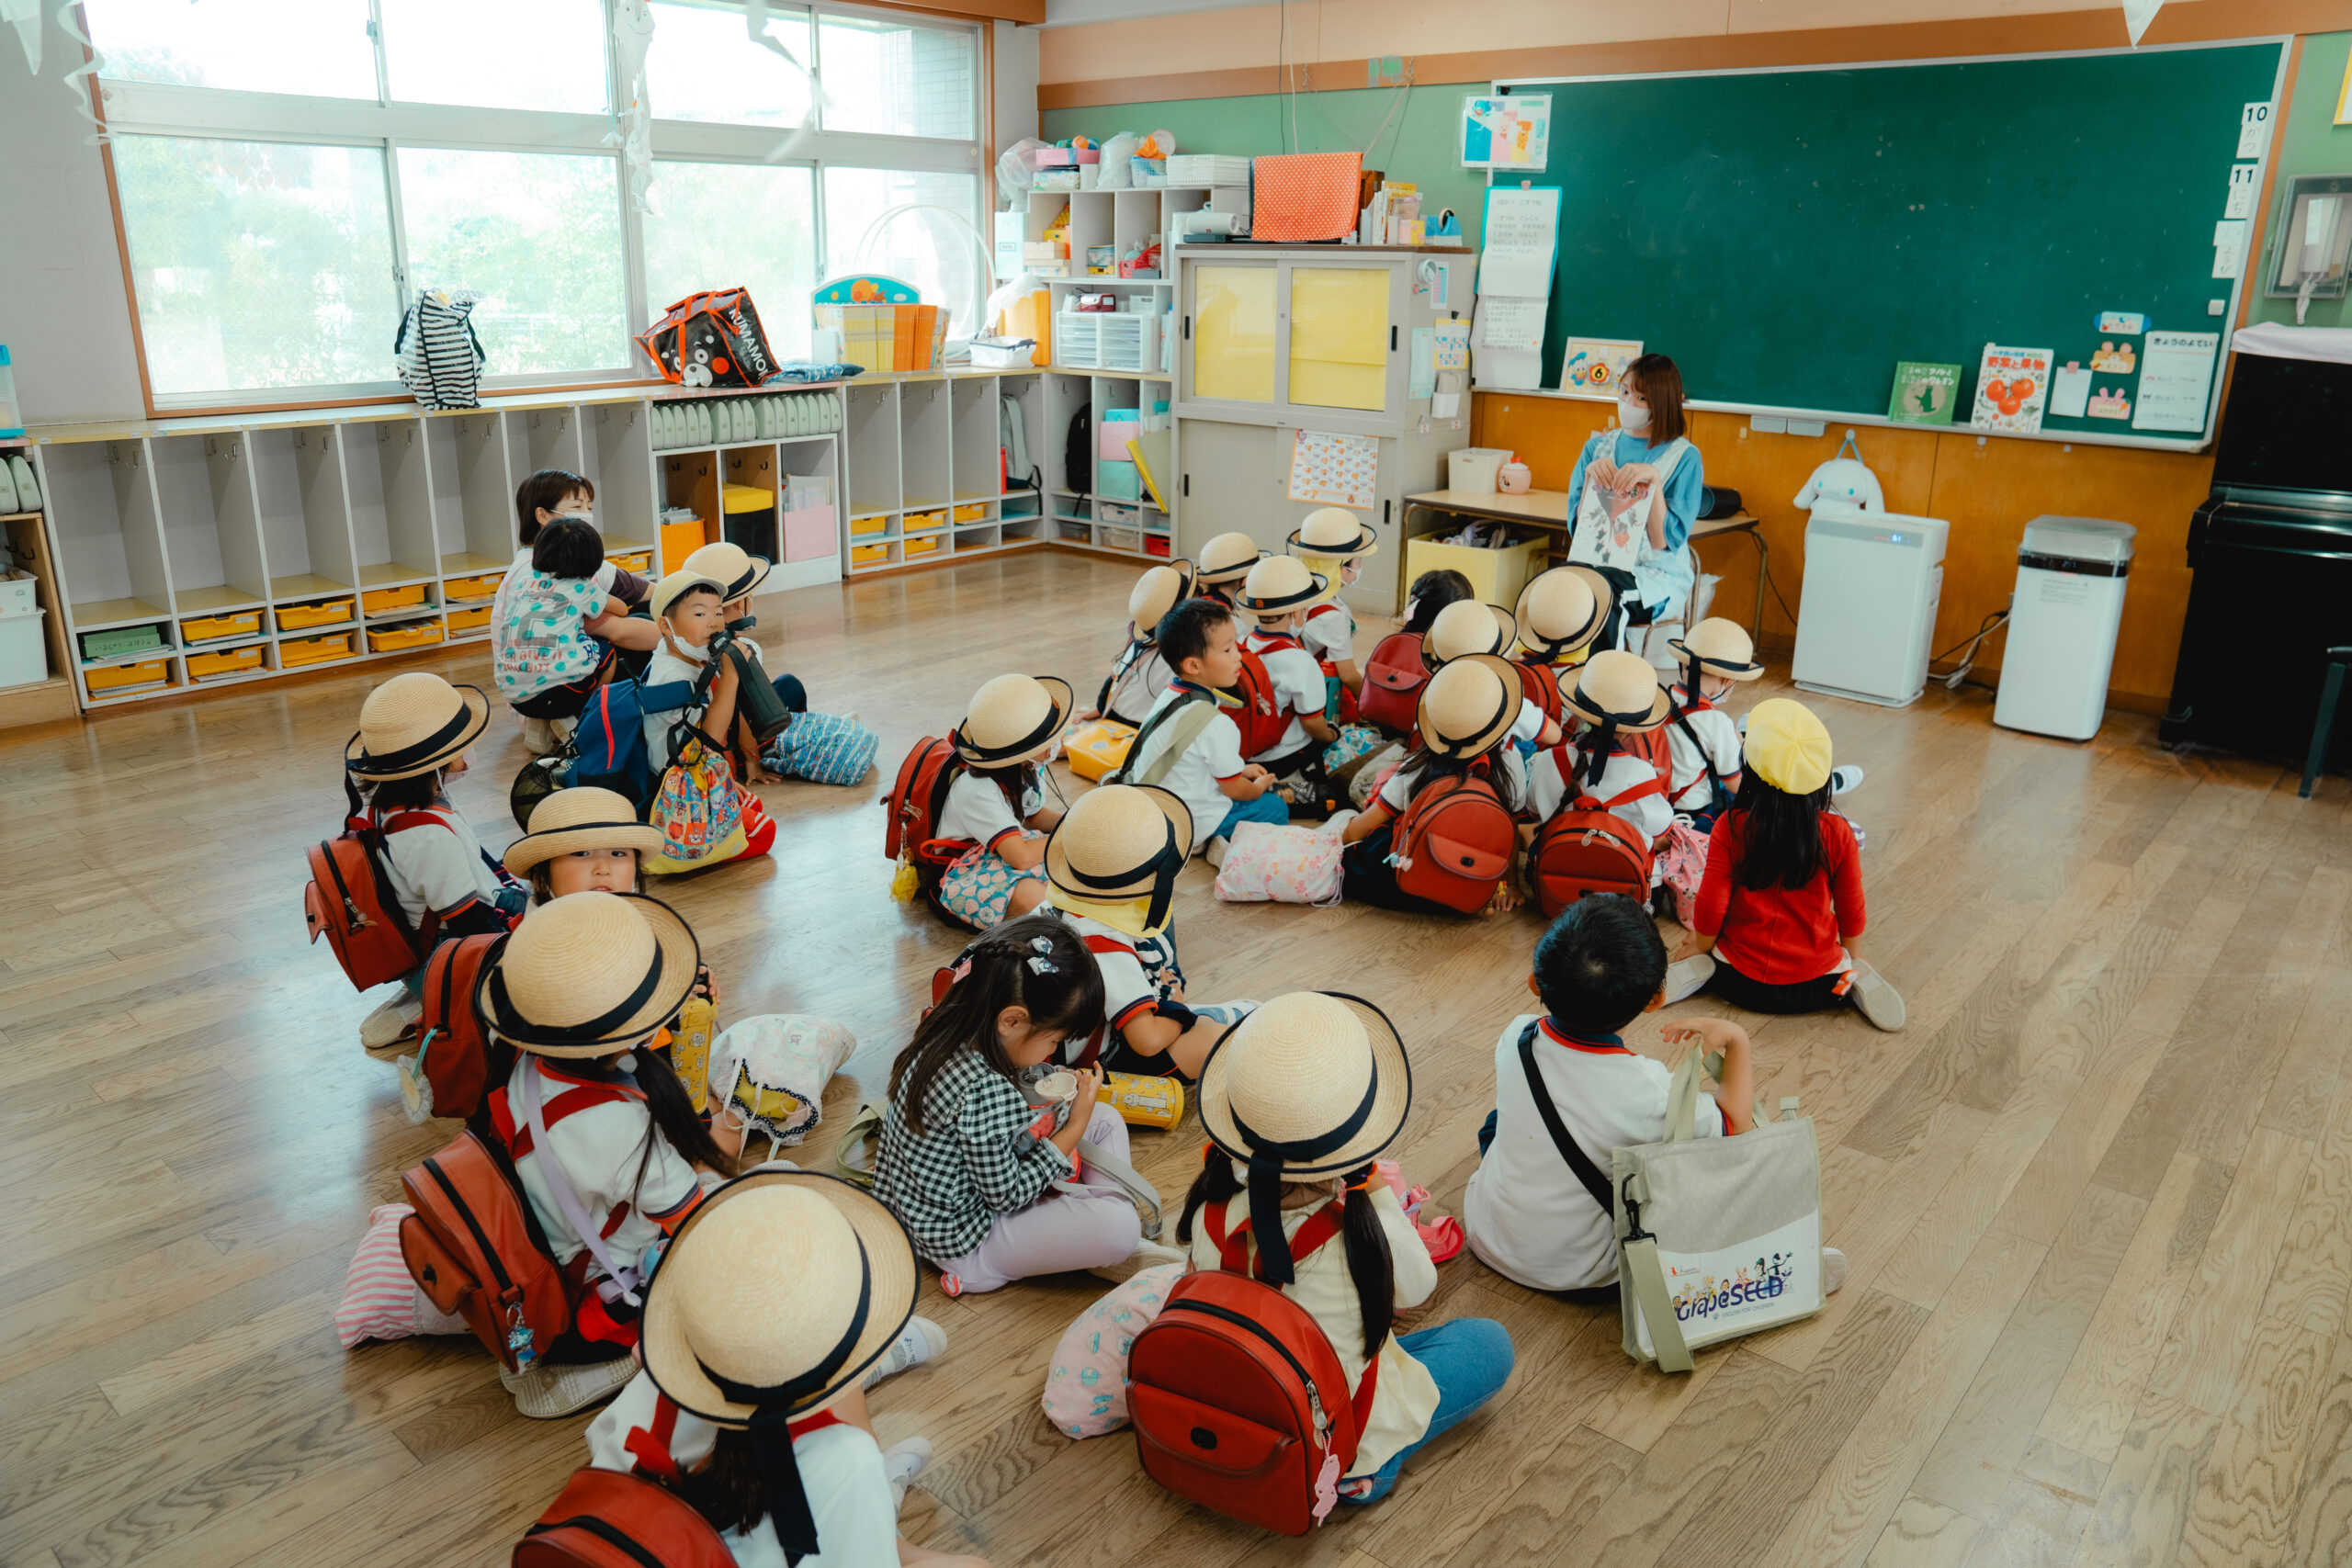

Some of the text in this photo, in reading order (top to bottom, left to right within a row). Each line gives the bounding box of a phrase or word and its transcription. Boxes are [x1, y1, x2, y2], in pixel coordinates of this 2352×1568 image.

[2247, 107, 2267, 122] 10
[2235, 169, 2253, 183] 11
[2154, 337, 2213, 347] きょうのよてい
[1595, 367, 1602, 379] 6
